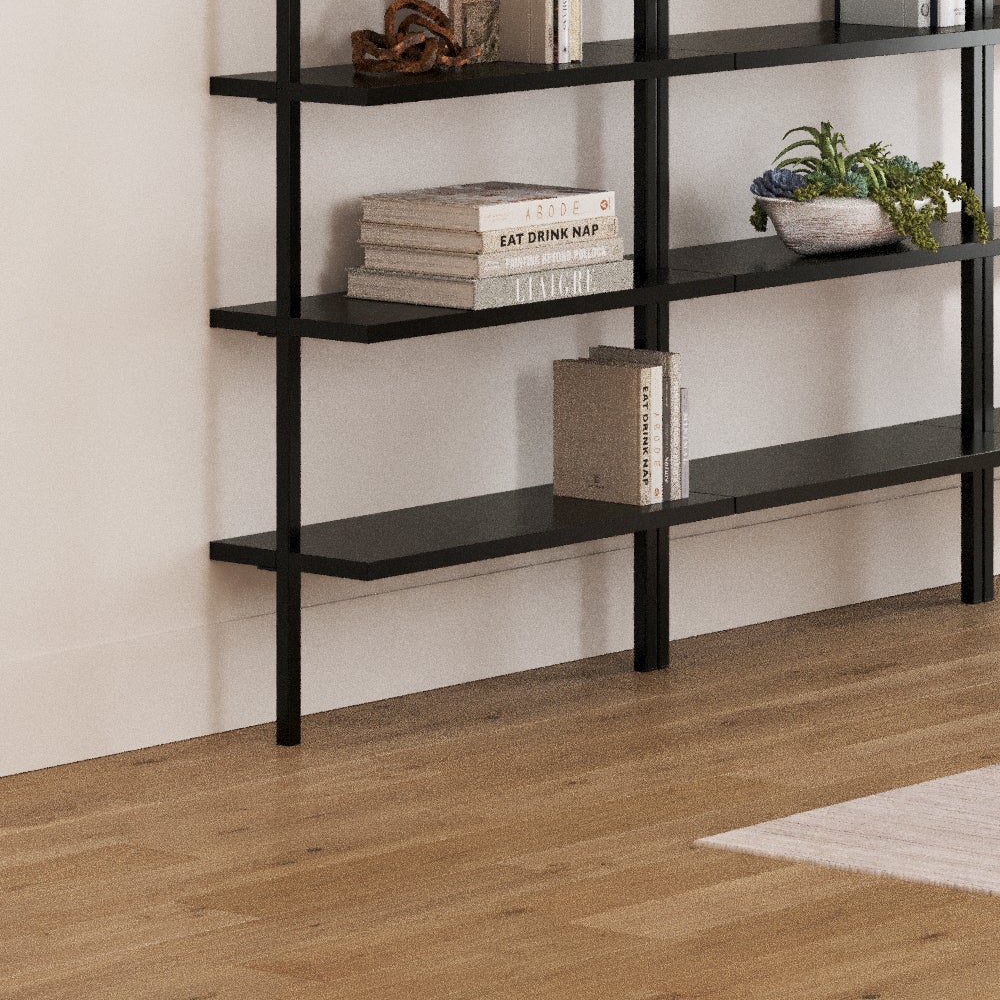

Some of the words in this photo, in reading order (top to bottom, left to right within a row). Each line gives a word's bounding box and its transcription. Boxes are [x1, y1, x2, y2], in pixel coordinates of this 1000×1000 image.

[525, 200, 580, 220] ABODE
[500, 232, 524, 248] EAT
[527, 227, 569, 244] DRINK
[572, 223, 599, 239] NAP
